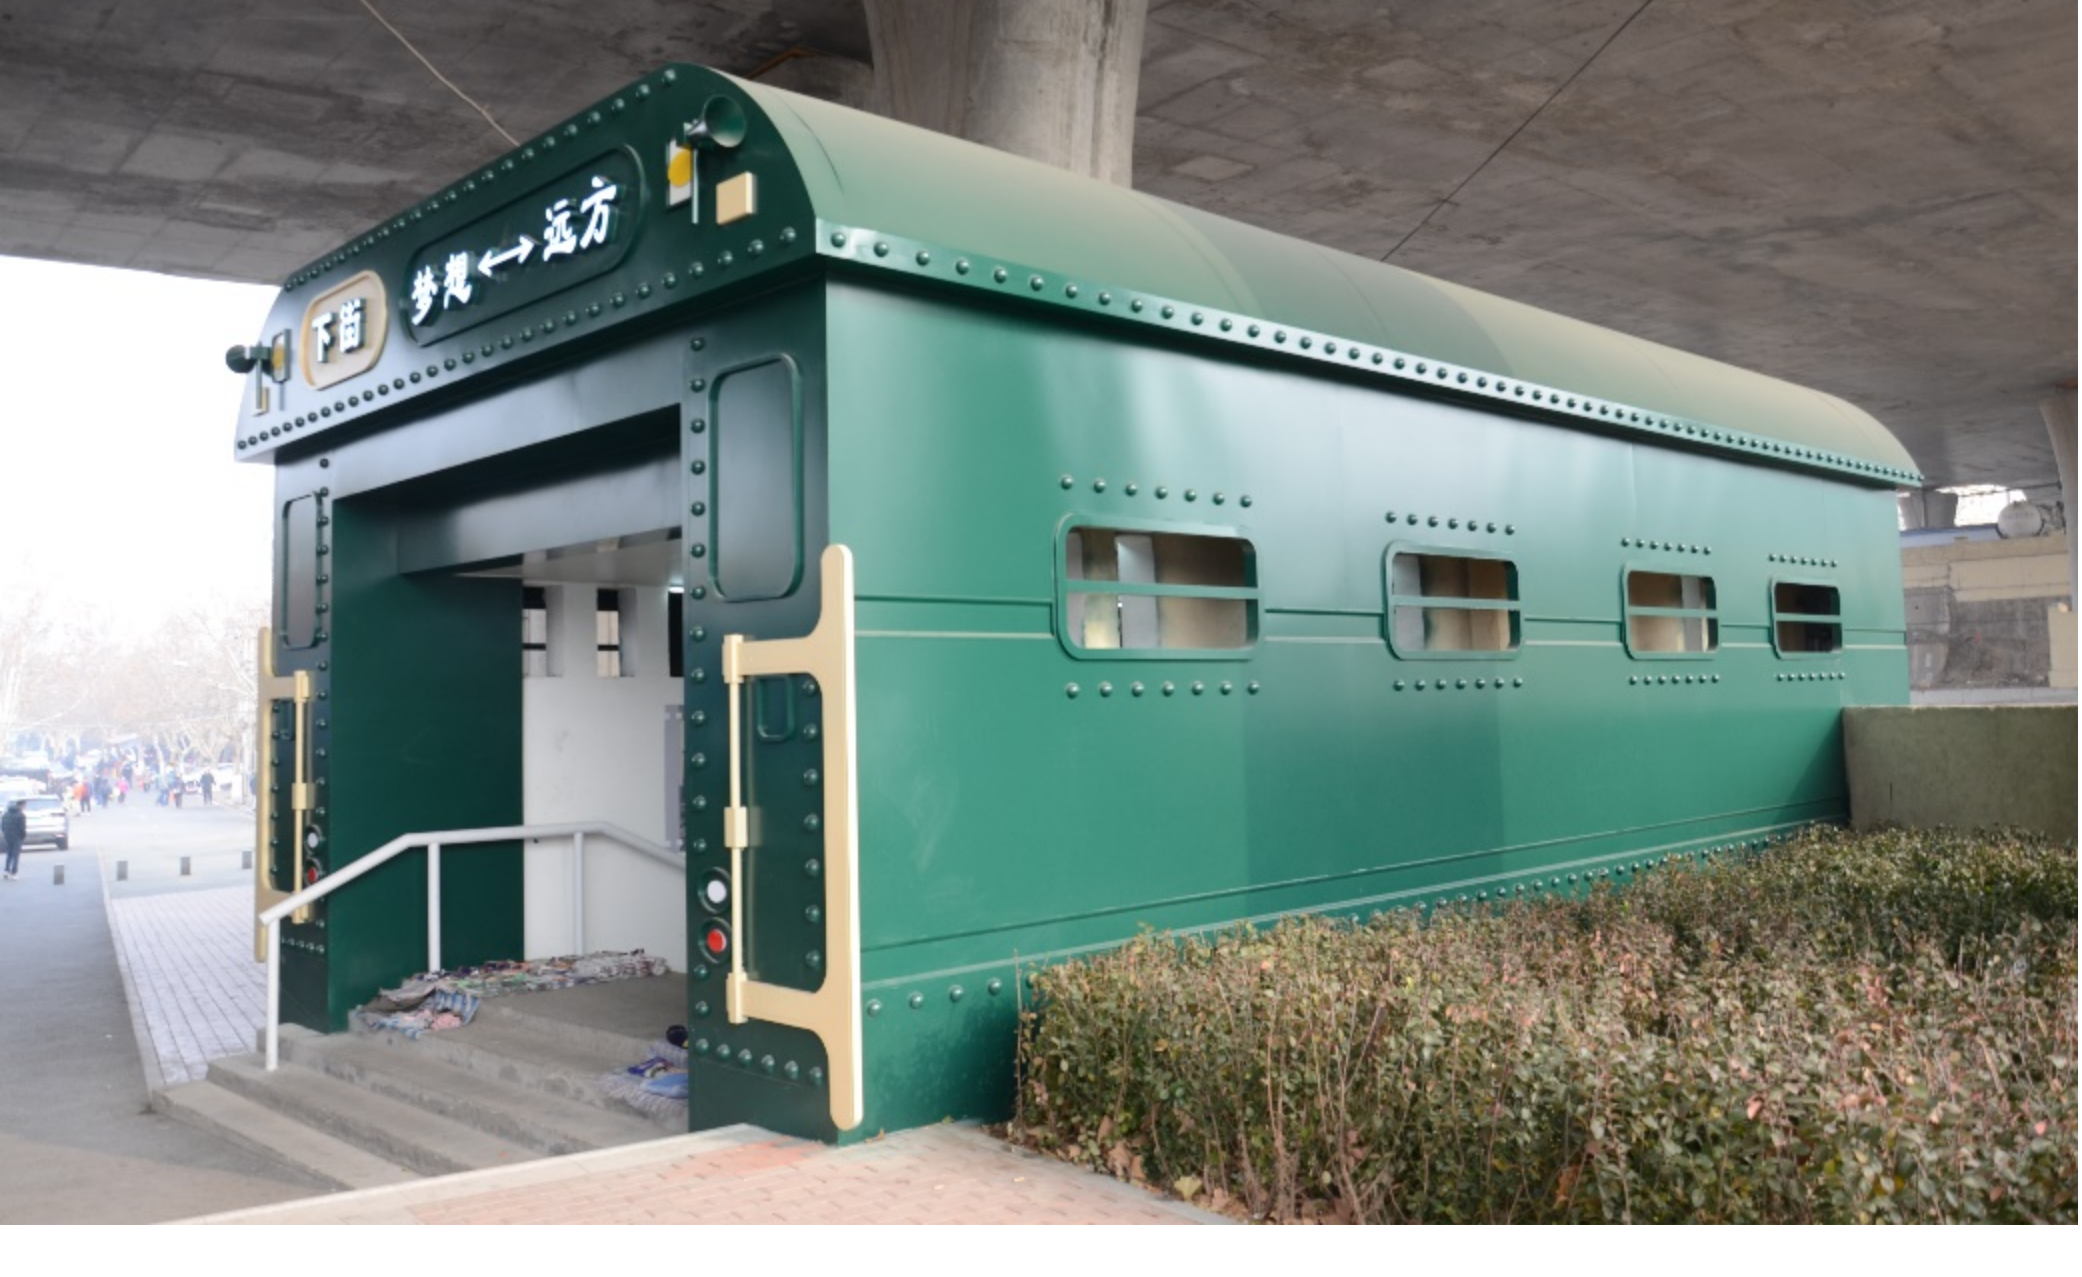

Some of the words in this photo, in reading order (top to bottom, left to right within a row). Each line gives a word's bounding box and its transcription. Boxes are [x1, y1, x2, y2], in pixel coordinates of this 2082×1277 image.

[411, 251, 472, 326] 梦想
[542, 175, 617, 262] 远方
[311, 297, 362, 363] 下街
